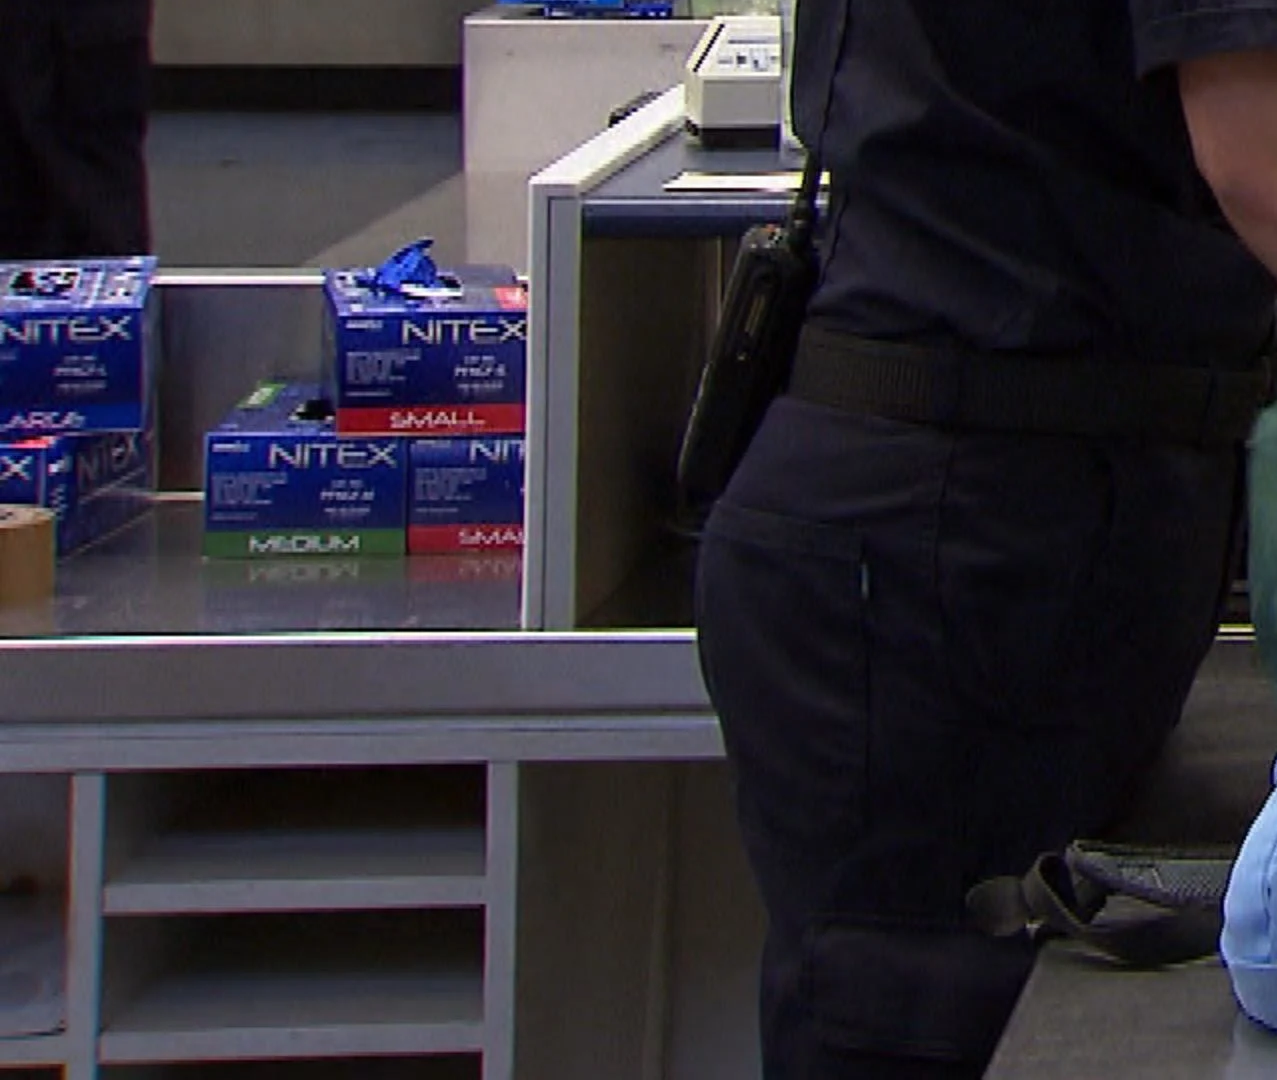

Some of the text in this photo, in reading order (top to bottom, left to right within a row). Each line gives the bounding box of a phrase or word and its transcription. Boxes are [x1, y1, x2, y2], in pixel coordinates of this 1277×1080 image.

[0, 316, 132, 345] NITEX
[402, 317, 527, 345] NITEX
[389, 410, 486, 429] SMALL
[269, 442, 398, 469] NITEX
[469, 439, 525, 462] NIT
[249, 534, 361, 553] MEDIUM
